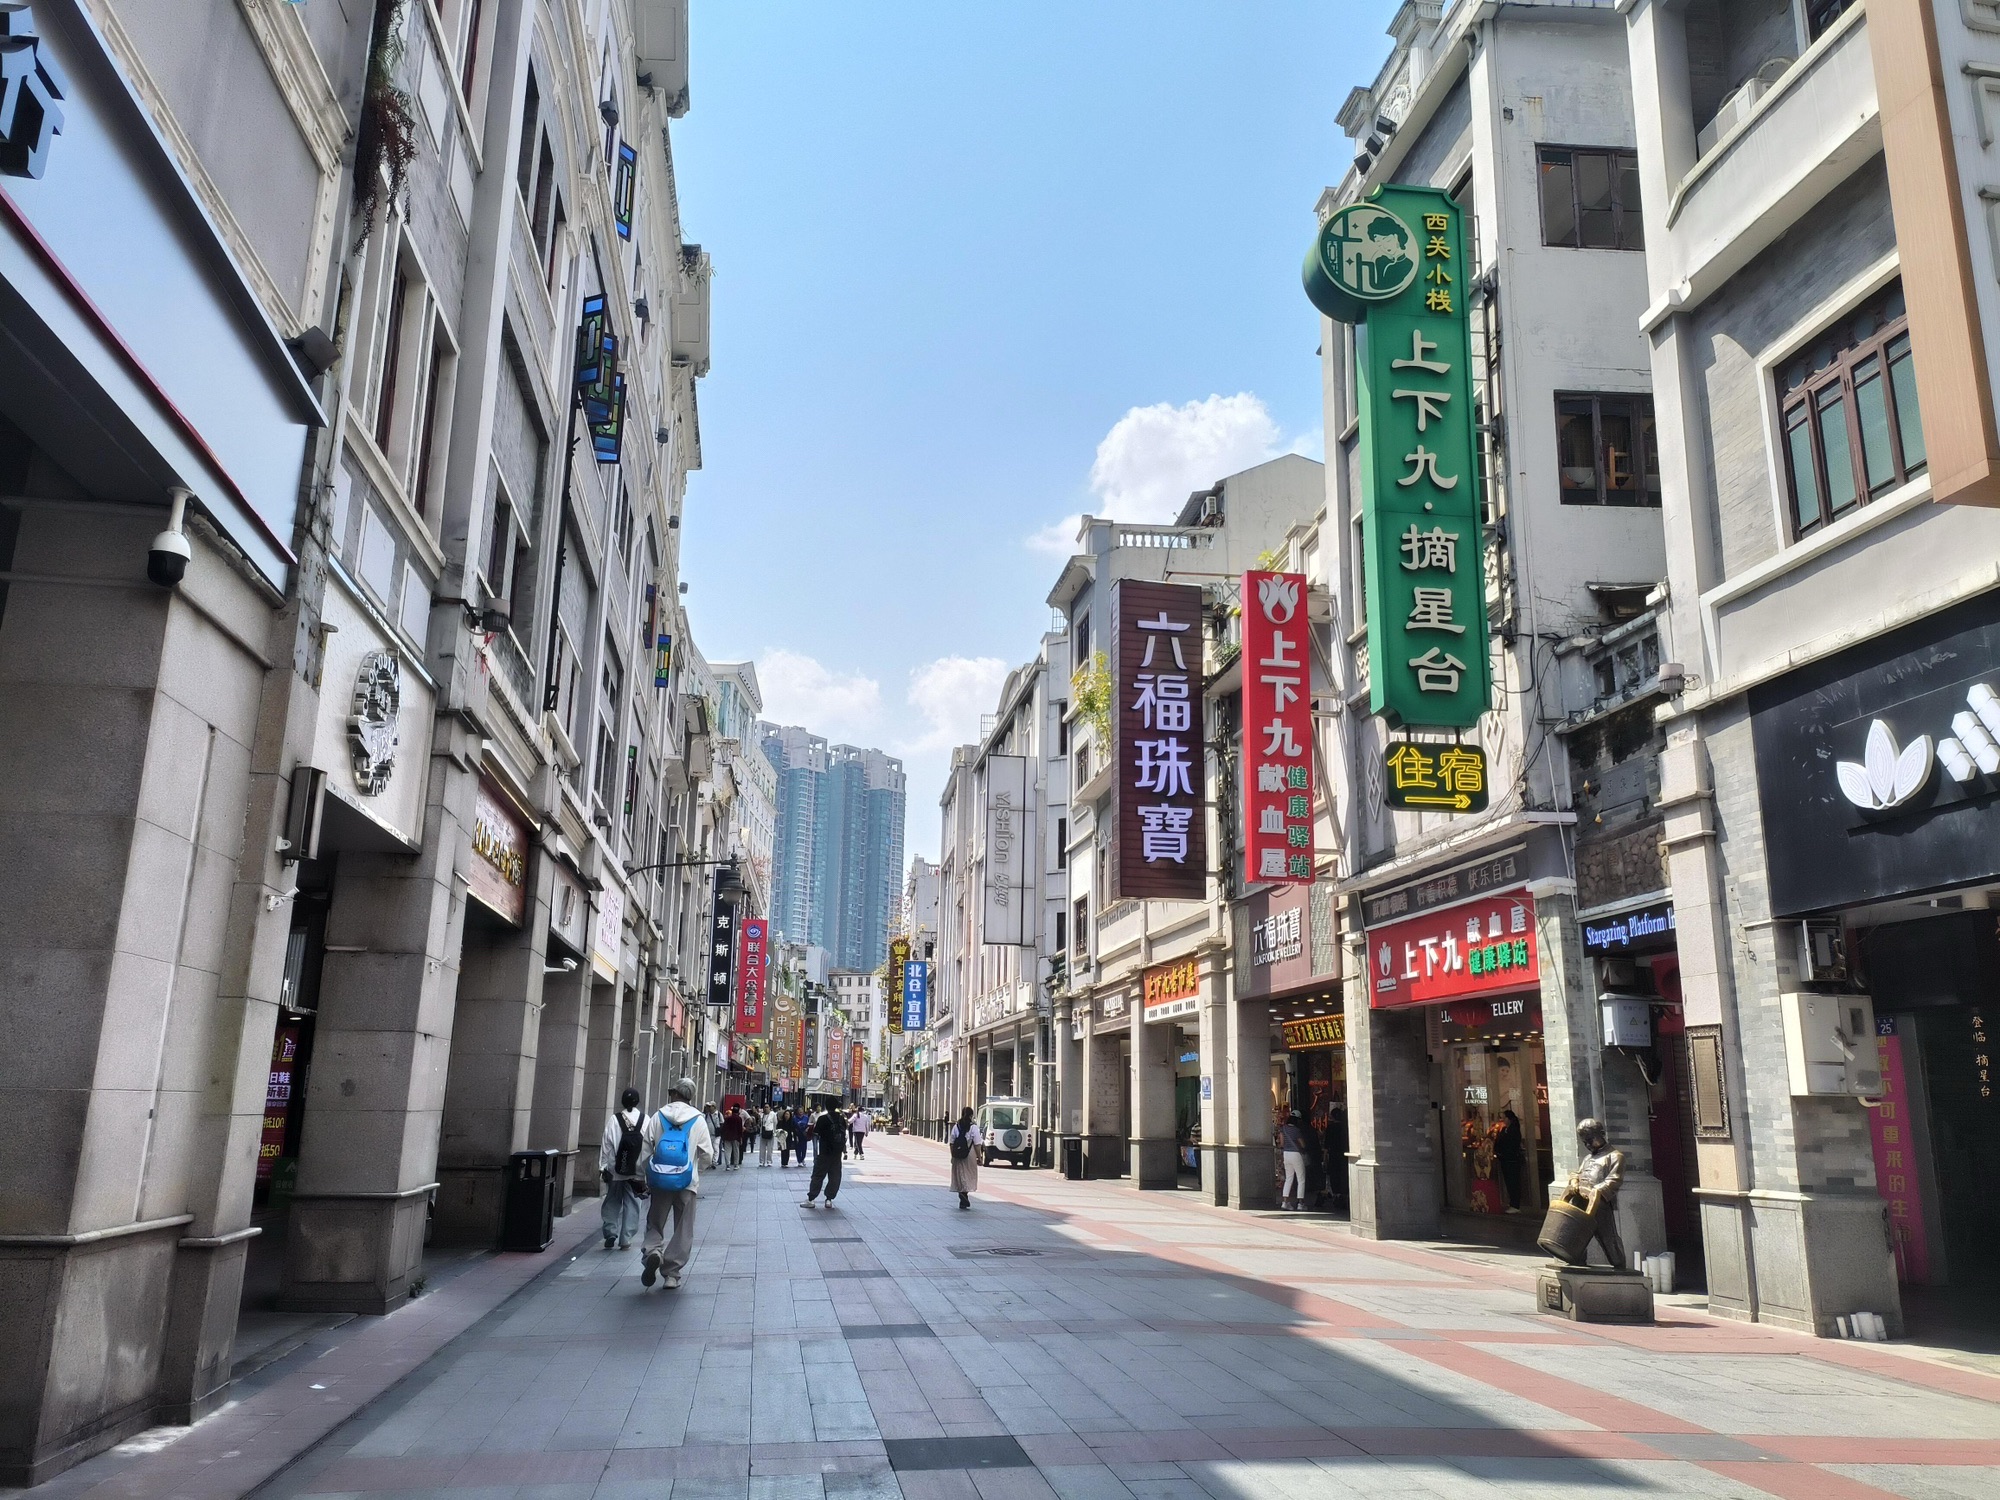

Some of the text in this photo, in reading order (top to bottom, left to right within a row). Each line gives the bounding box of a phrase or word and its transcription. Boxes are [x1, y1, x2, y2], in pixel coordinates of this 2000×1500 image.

[1424, 212, 1453, 313] 西关小栈
[1131, 611, 1194, 864] 六福珠寶
[1387, 745, 1484, 795] 住宿
[1287, 765, 1311, 878] 健康驿站
[1417, 874, 1458, 906] 行善积德
[1468, 856, 1516, 890] 快乐自己
[713, 893, 730, 986] 克斯顿
[1253, 906, 1302, 953] 六福珠寶
[1401, 905, 1527, 979] 上下九 献血屋
[1629, 913, 1667, 937] Platform
[1469, 939, 1528, 974] 健康驿站
[1491, 999, 1524, 1017] ELLERY
[1880, 1024, 1892, 1034] 25
[775, 1015, 786, 1062] 中国黄金
[832, 1044, 840, 1078] 中国黄金
[1464, 1087, 1488, 1099] 六福
